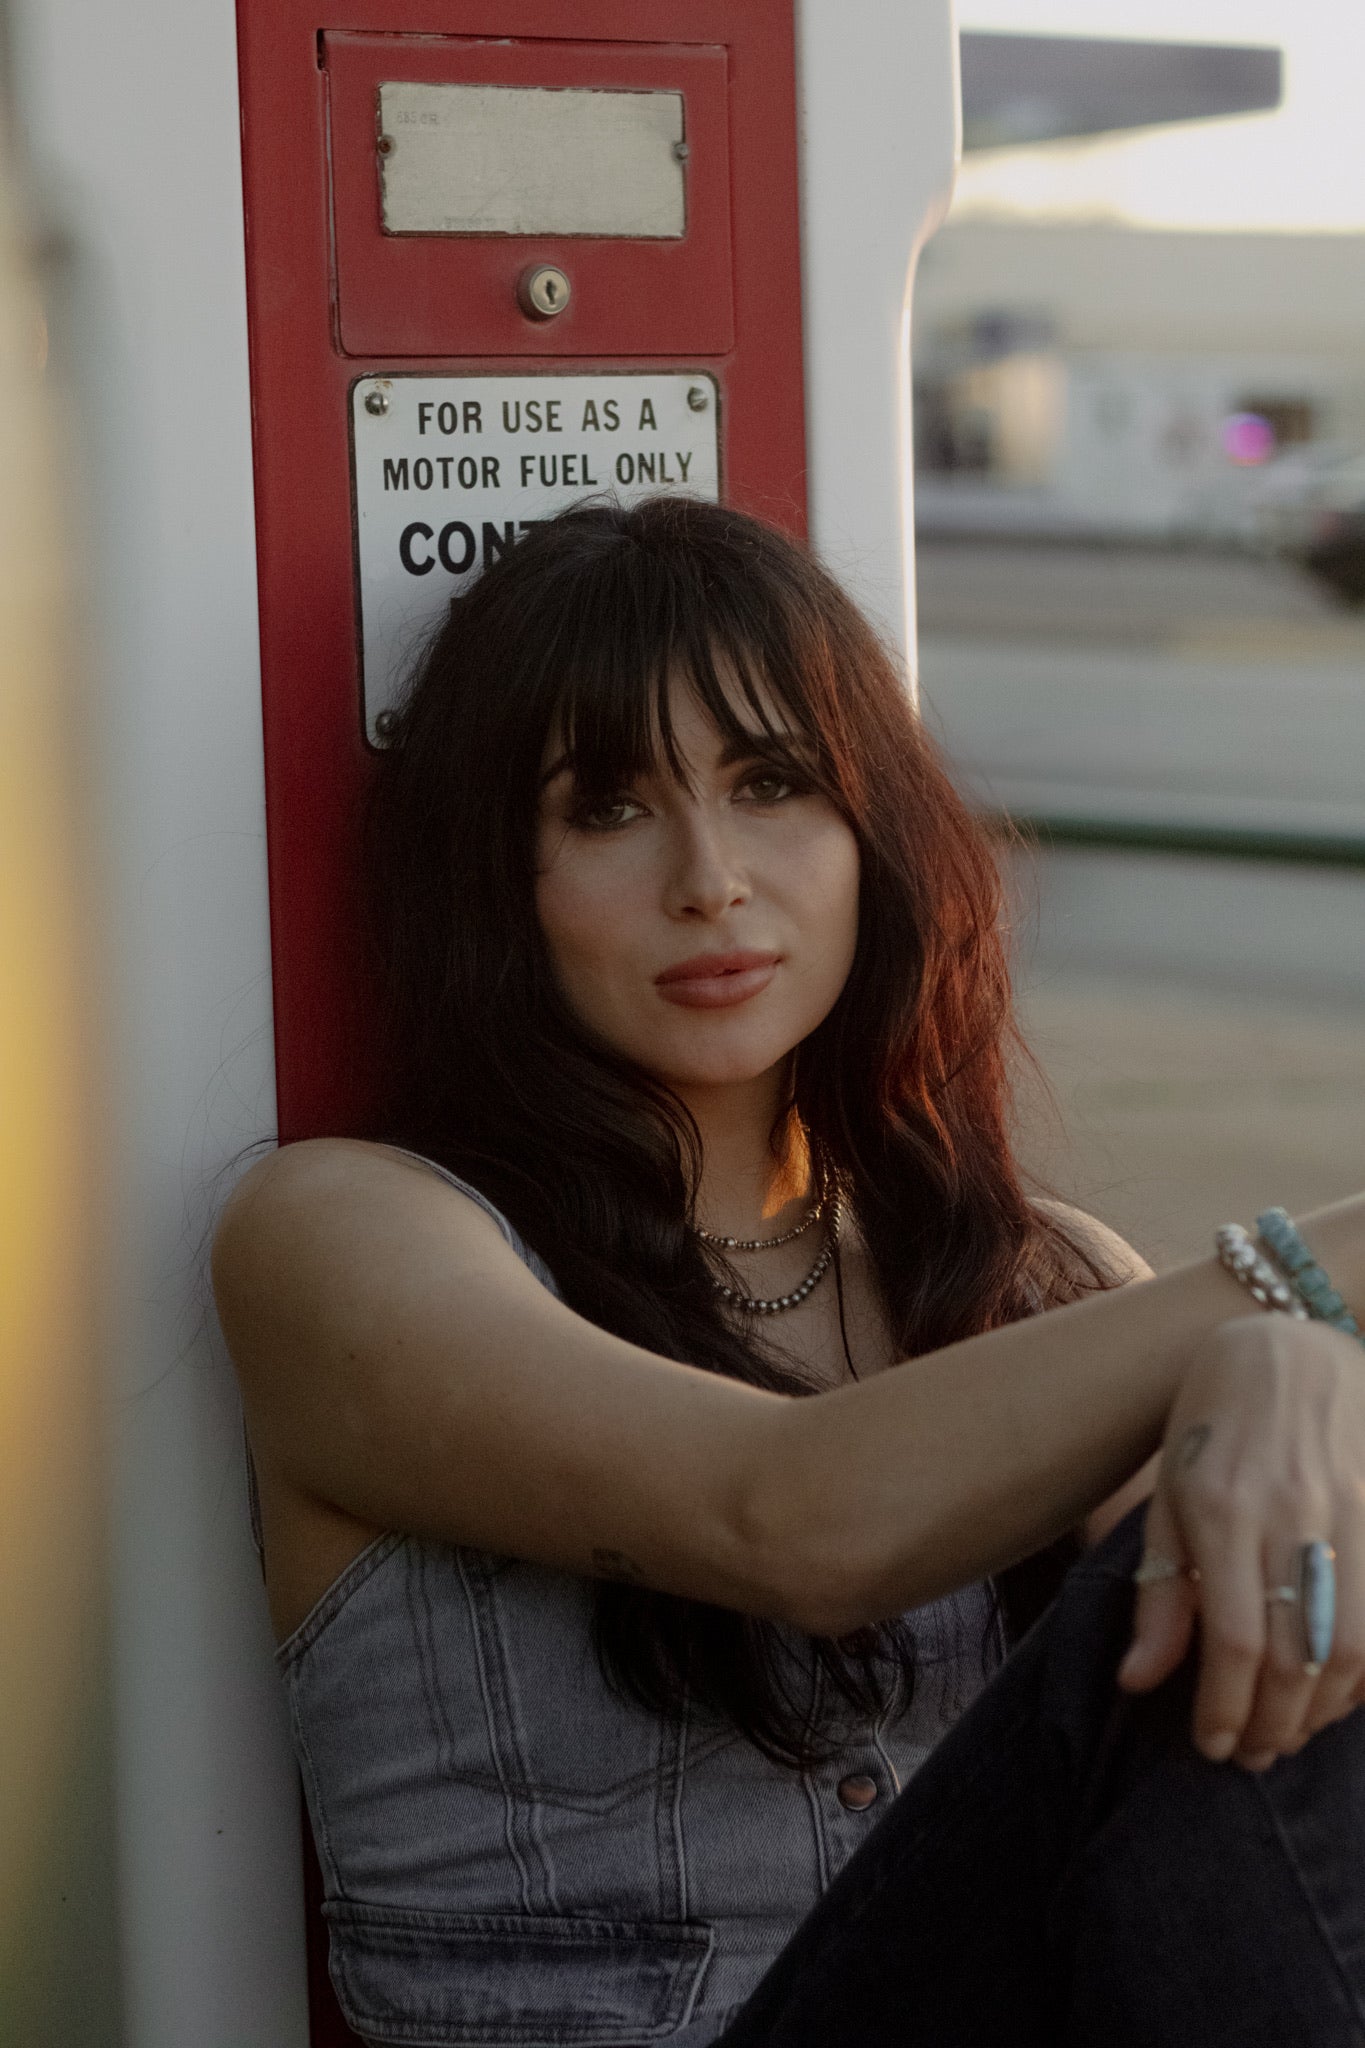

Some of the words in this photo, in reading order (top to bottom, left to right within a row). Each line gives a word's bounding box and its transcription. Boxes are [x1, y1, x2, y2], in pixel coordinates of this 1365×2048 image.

[418, 402, 482, 435] FOR
[502, 401, 563, 433] USE
[581, 399, 620, 432] AS
[638, 398, 658, 431] A
[383, 456, 500, 491] MOTOR
[520, 454, 597, 487] FUEL
[616, 452, 693, 485] ONLY
